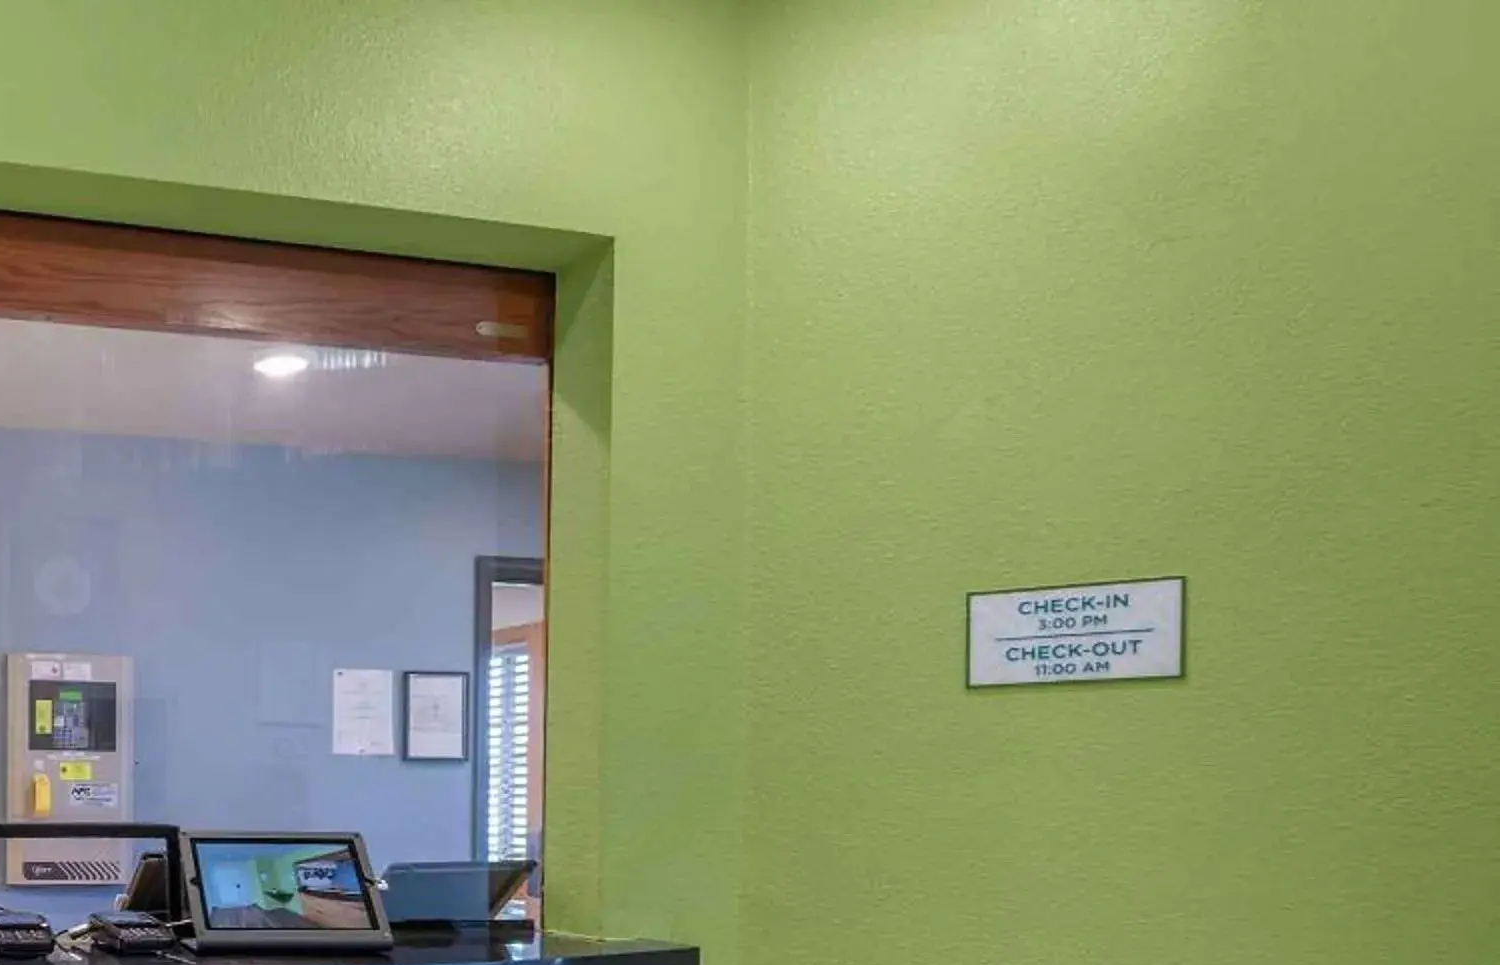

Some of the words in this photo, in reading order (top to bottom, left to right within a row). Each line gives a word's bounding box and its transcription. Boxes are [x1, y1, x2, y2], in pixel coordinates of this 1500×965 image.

[1018, 593, 1129, 615] CHECK-IN
[1039, 617, 1077, 631] 3:00
[1082, 614, 1108, 628] PM
[1005, 639, 1143, 661] CHECK-OUT
[1035, 663, 1077, 677] 11:00
[1082, 661, 1110, 674] AM
